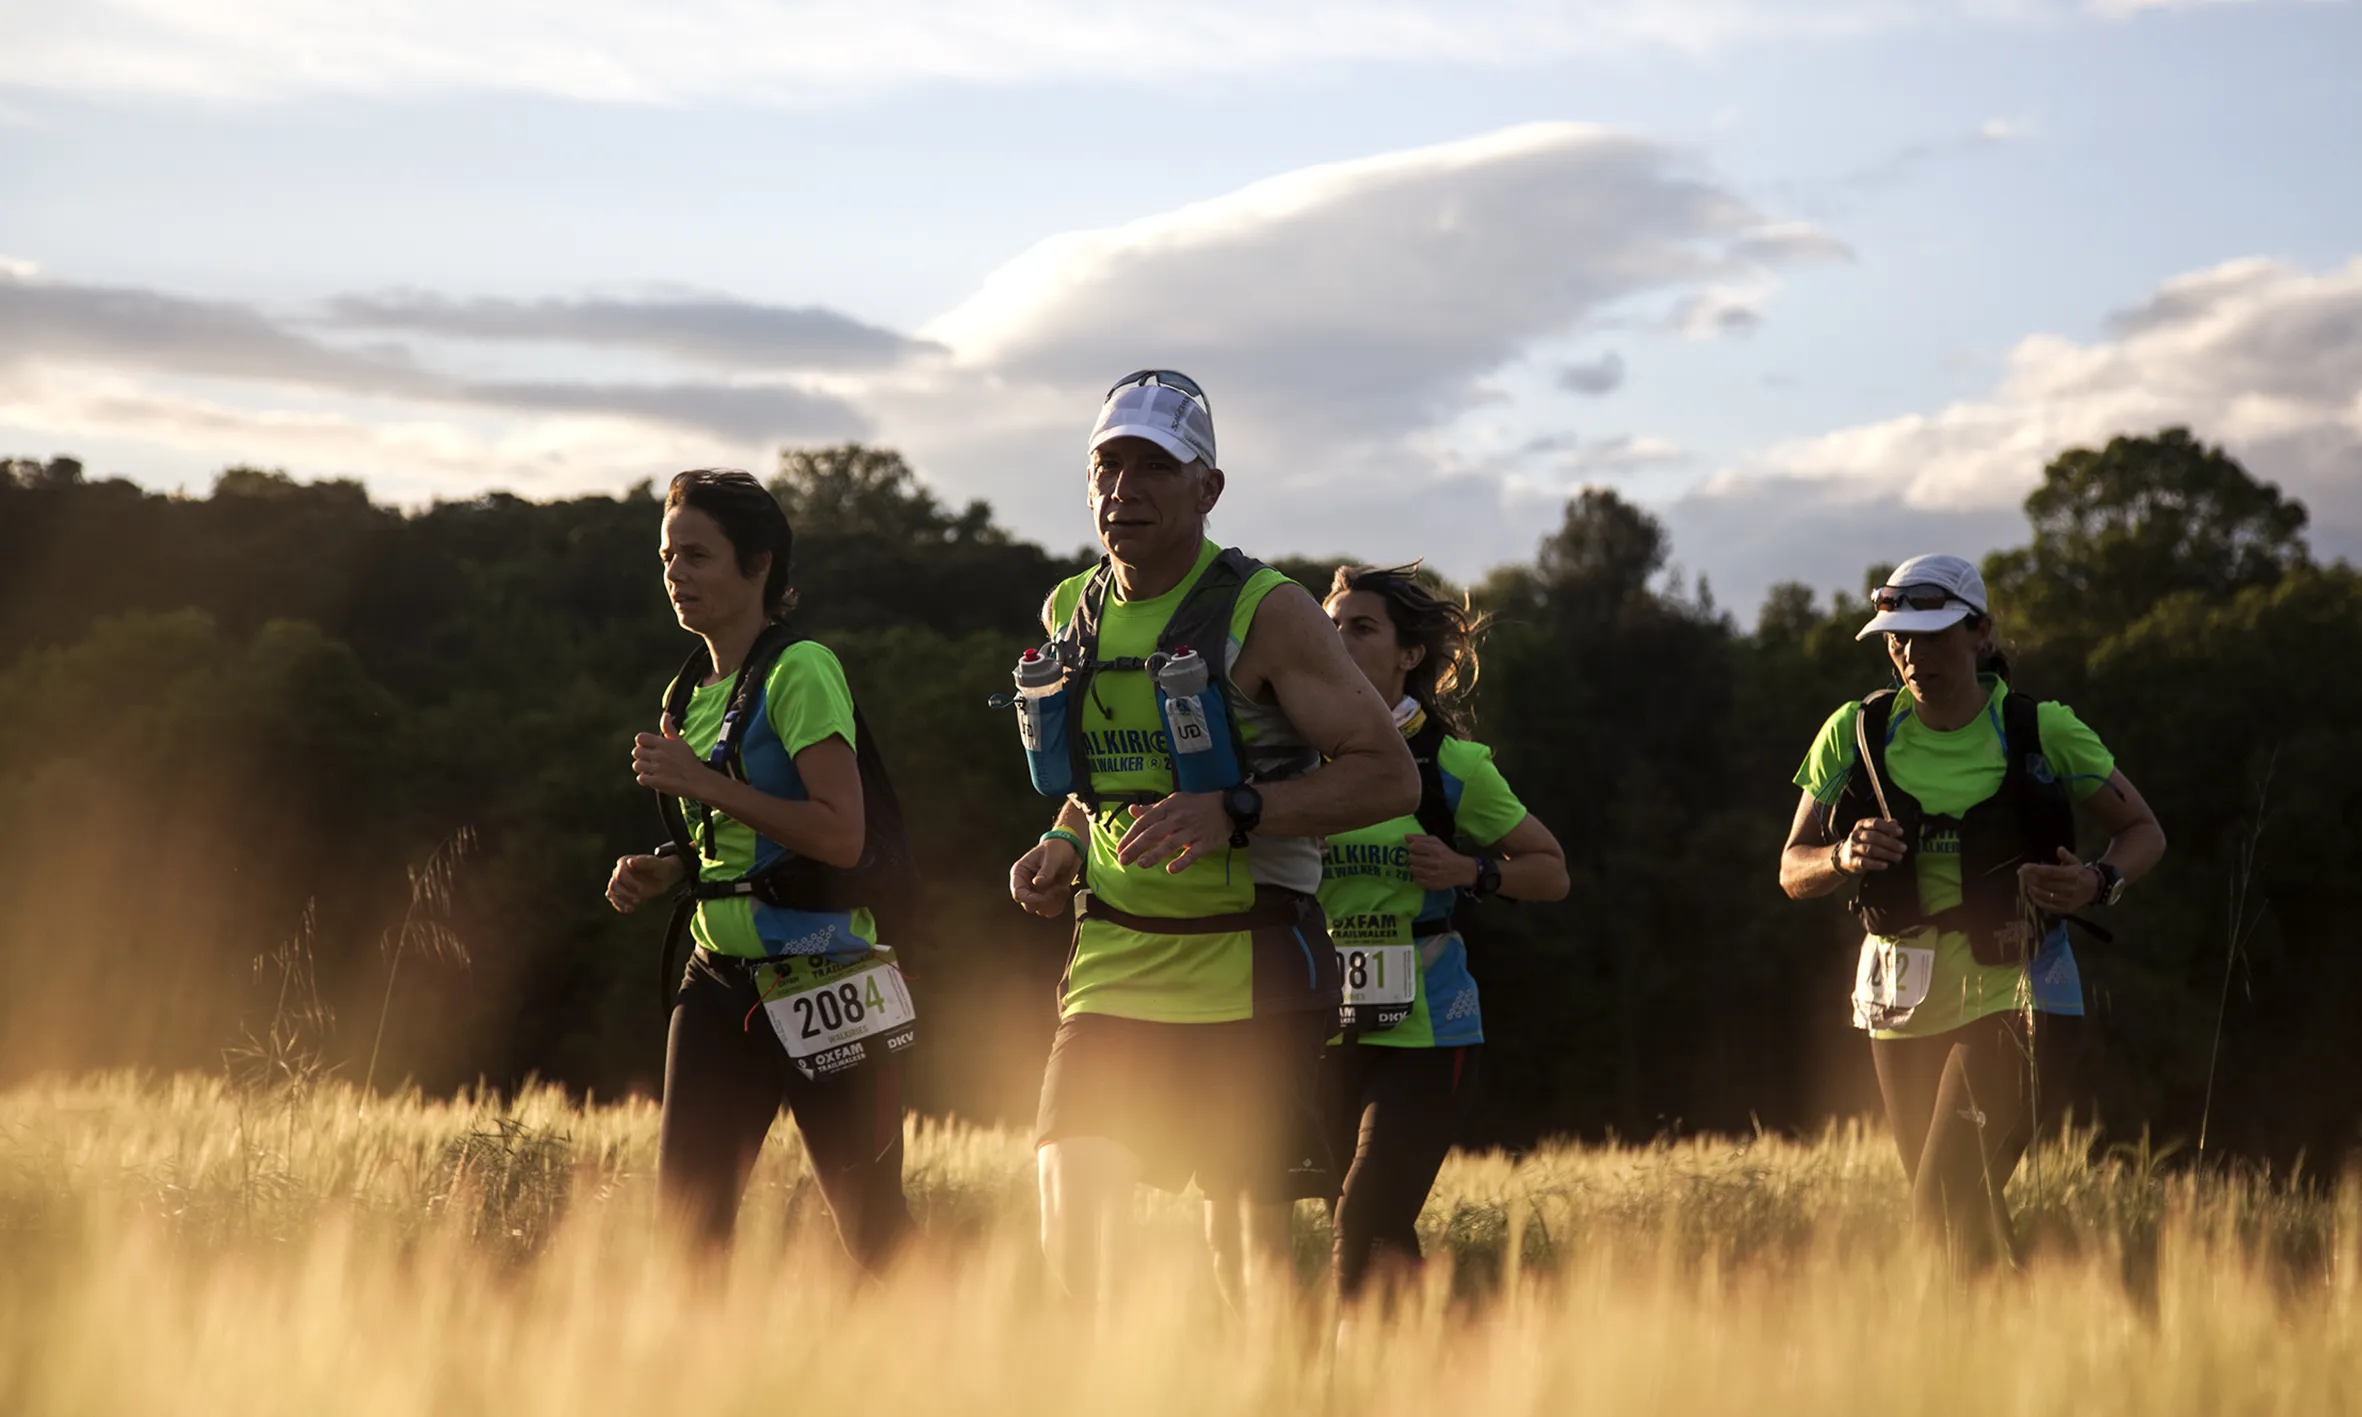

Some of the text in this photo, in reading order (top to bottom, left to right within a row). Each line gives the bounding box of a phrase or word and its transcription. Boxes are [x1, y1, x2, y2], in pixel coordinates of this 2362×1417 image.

[1082, 730, 1170, 755] ALKIRIE
[1322, 844, 1409, 867] ALKIRIE
[793, 975, 885, 1039] 2084
[887, 1031, 914, 1050] DKV
[815, 1042, 864, 1066] OXFAM
[817, 1053, 867, 1073] TRAILWALKER
